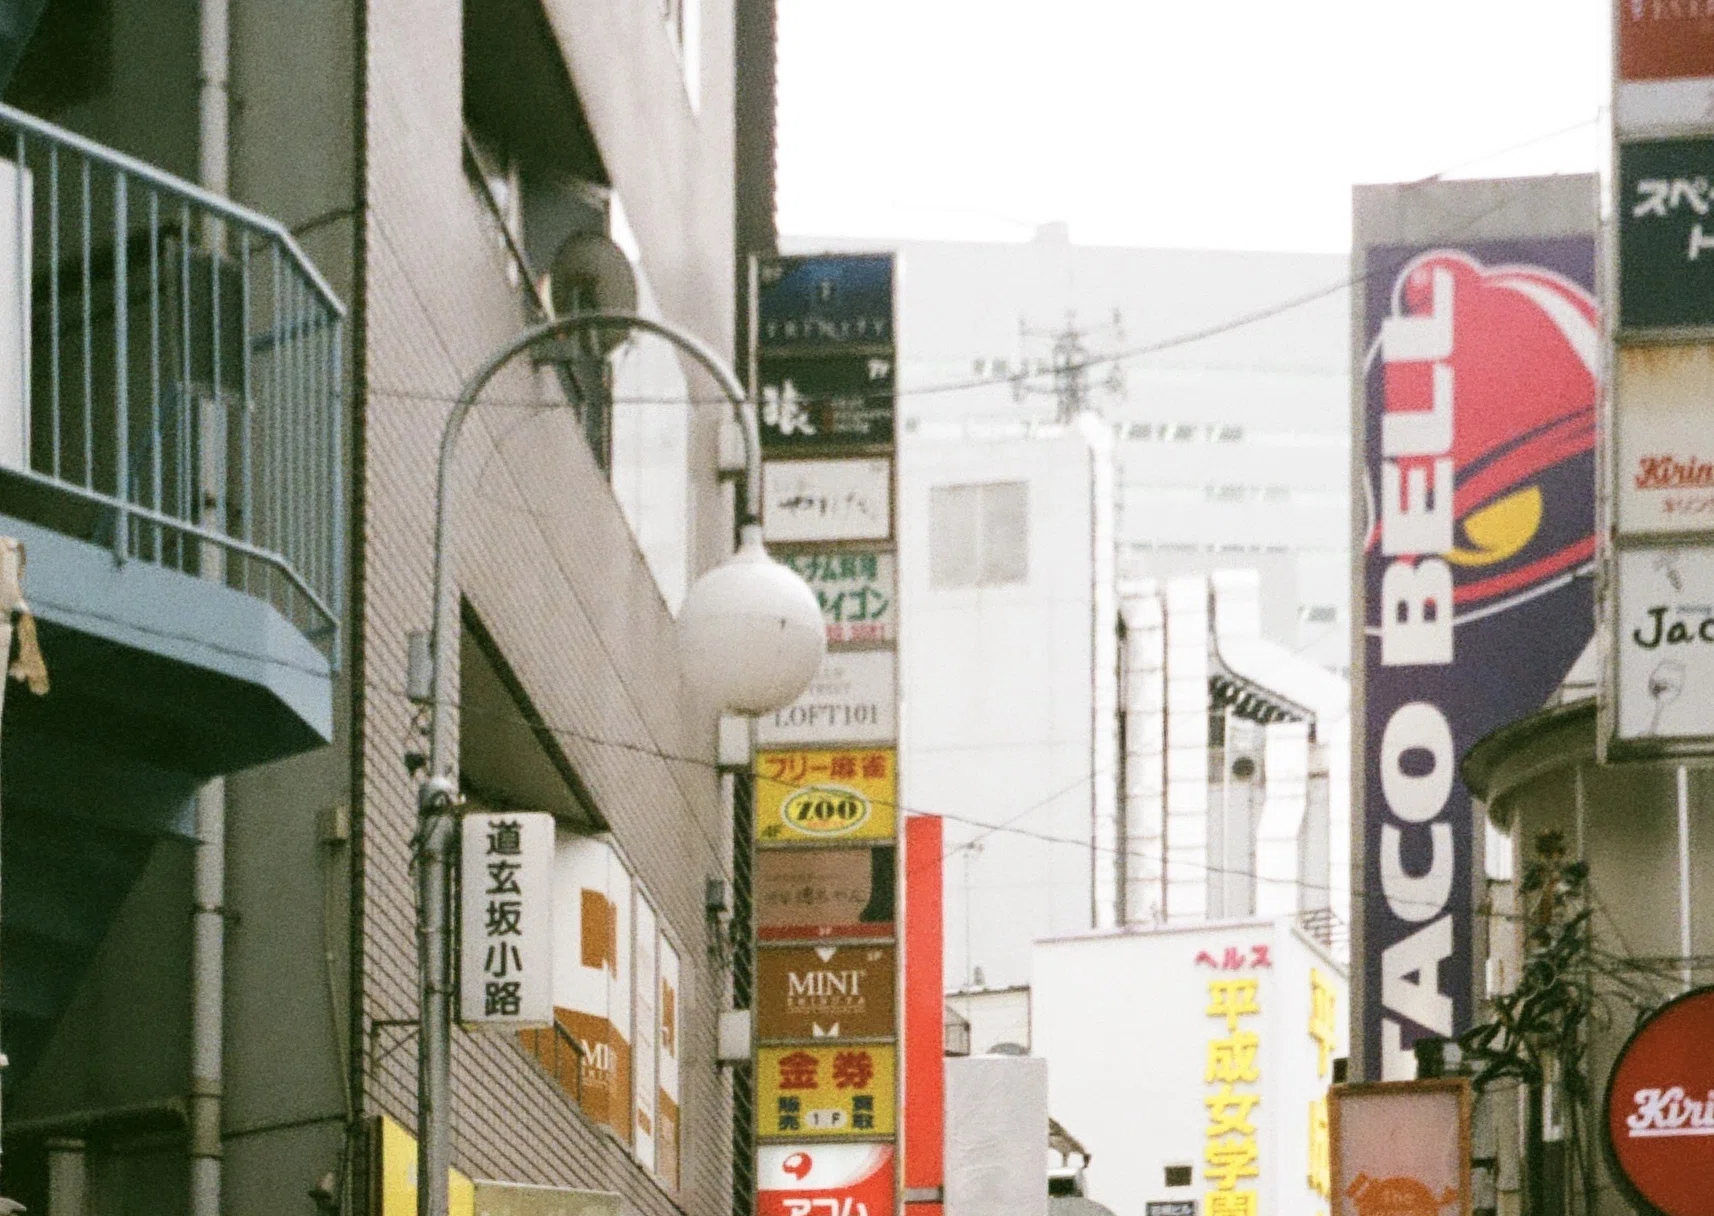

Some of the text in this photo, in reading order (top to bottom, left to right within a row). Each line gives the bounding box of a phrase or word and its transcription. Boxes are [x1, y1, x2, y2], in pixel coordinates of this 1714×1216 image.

[1382, 265, 1455, 665] BELL
[484, 819, 523, 1018] 道玄坂小路
[1194, 945, 1272, 970] ヘルス
[787, 970, 864, 997] MINT
